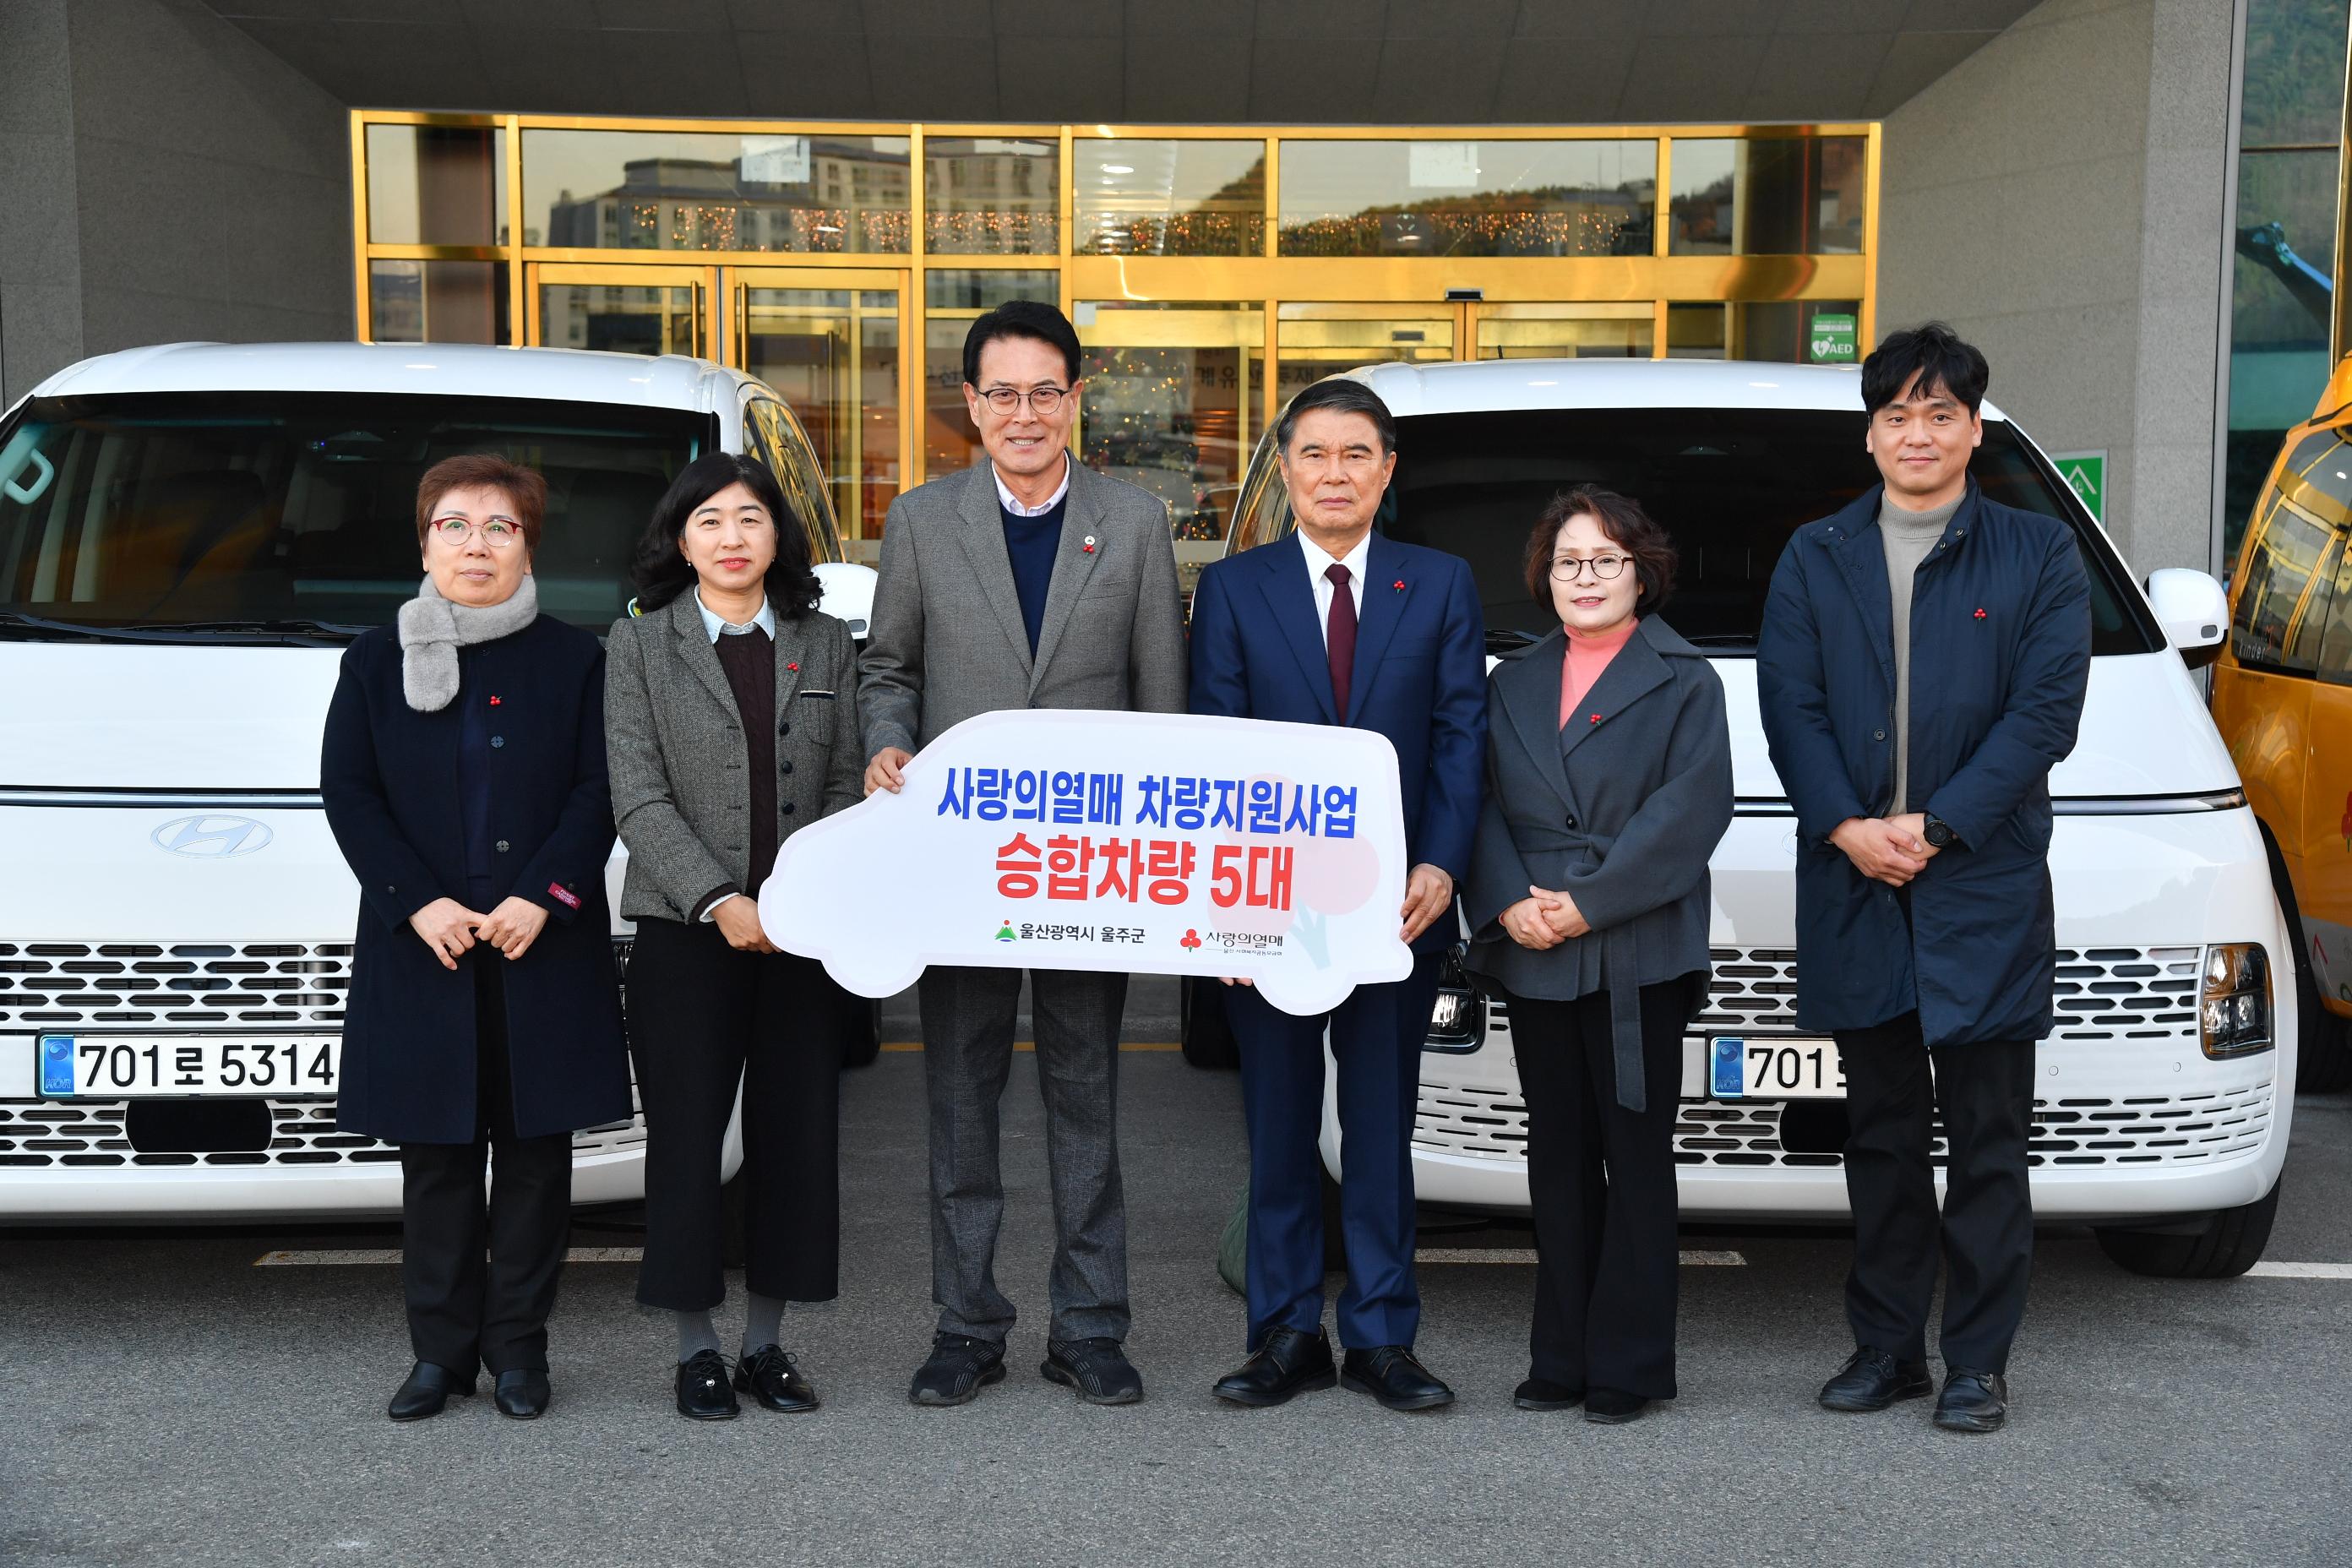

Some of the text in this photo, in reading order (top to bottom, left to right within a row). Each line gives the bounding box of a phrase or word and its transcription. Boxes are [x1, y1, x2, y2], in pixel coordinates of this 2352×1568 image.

[1829, 343, 1854, 355] AED
[938, 766, 1358, 839] 사랑의열매 차량지원사업
[995, 831, 1294, 912] 승합차량 5대
[1020, 923, 1146, 944] 울산광역시 울주군
[1206, 932, 1283, 949] 사랑의열매
[79, 1043, 335, 1087] 701로 5314
